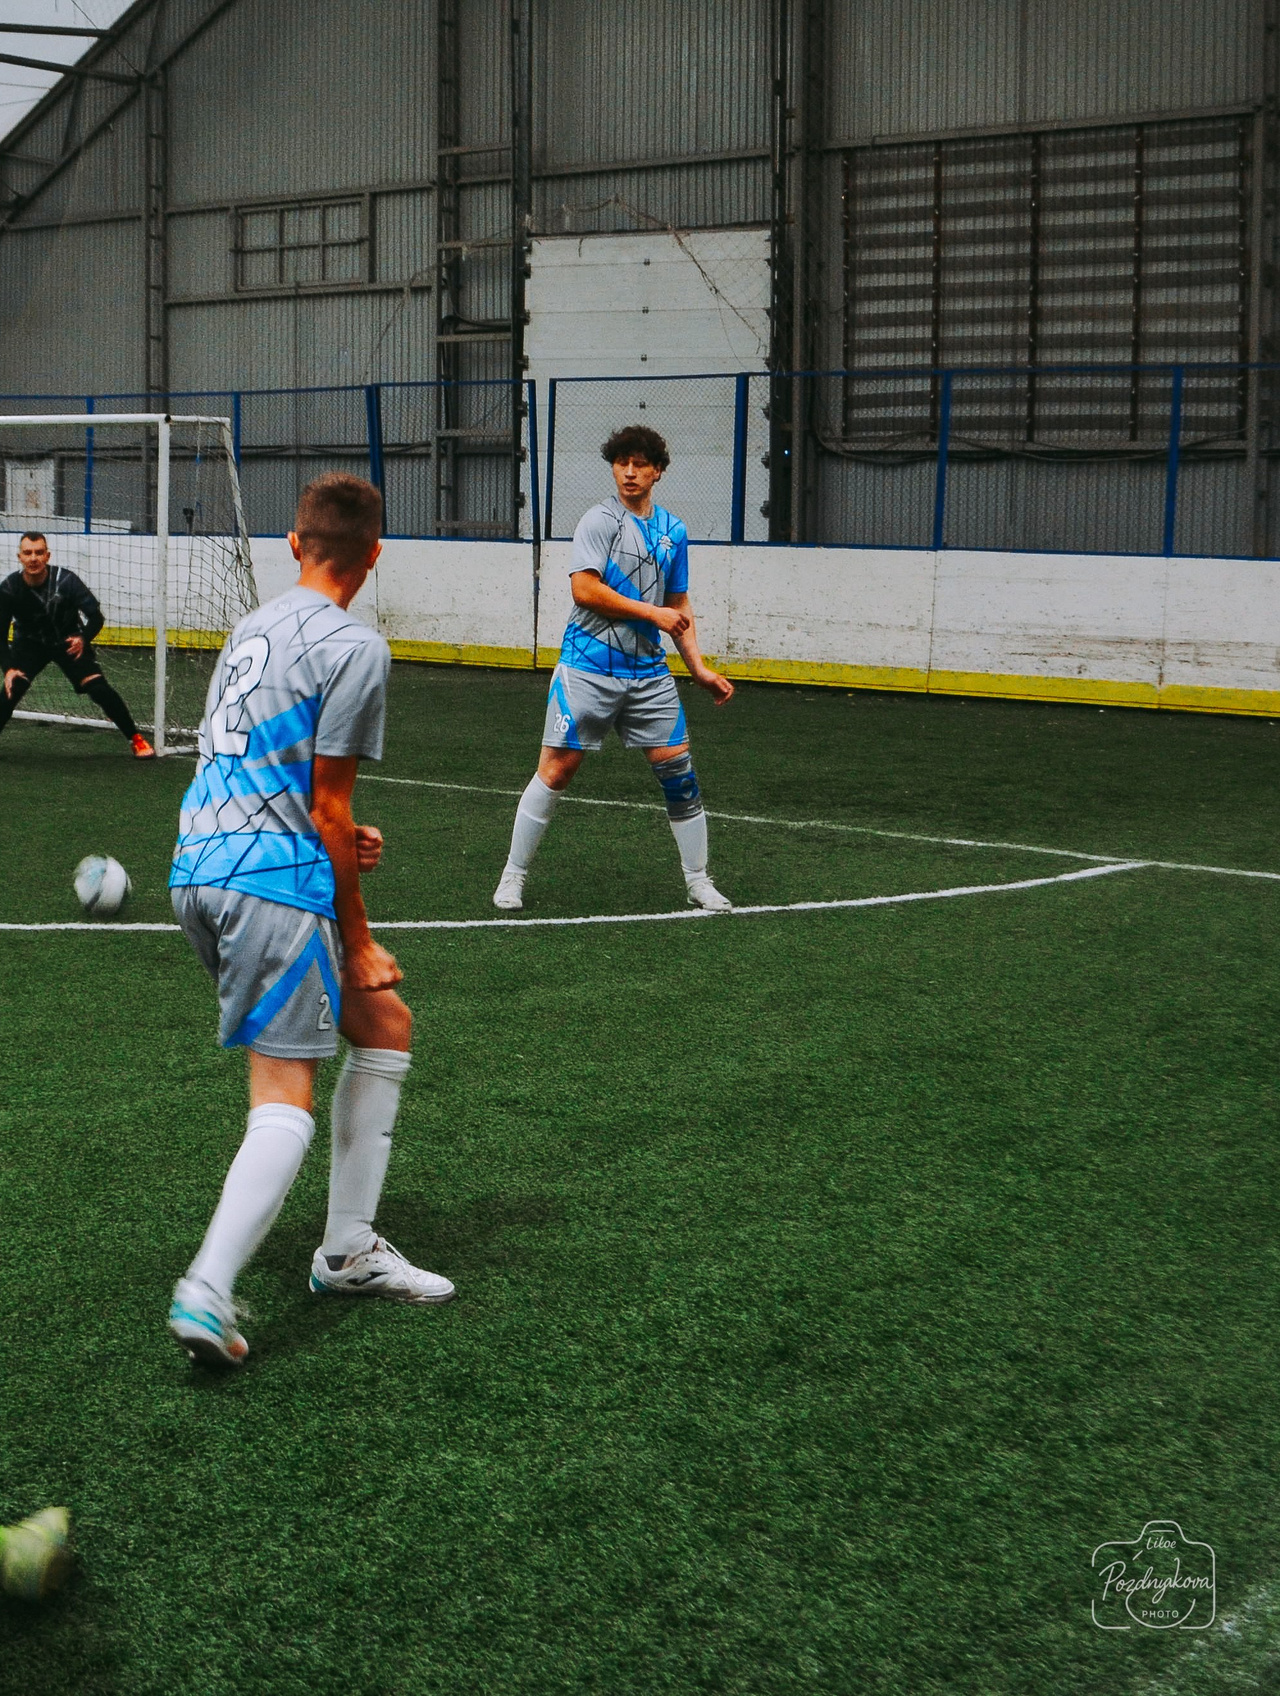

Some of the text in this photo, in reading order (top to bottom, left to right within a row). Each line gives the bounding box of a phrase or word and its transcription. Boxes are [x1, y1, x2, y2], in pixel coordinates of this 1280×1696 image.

[210, 634, 270, 757] 2
[553, 712, 571, 733] 26
[317, 992, 331, 1031] 2
